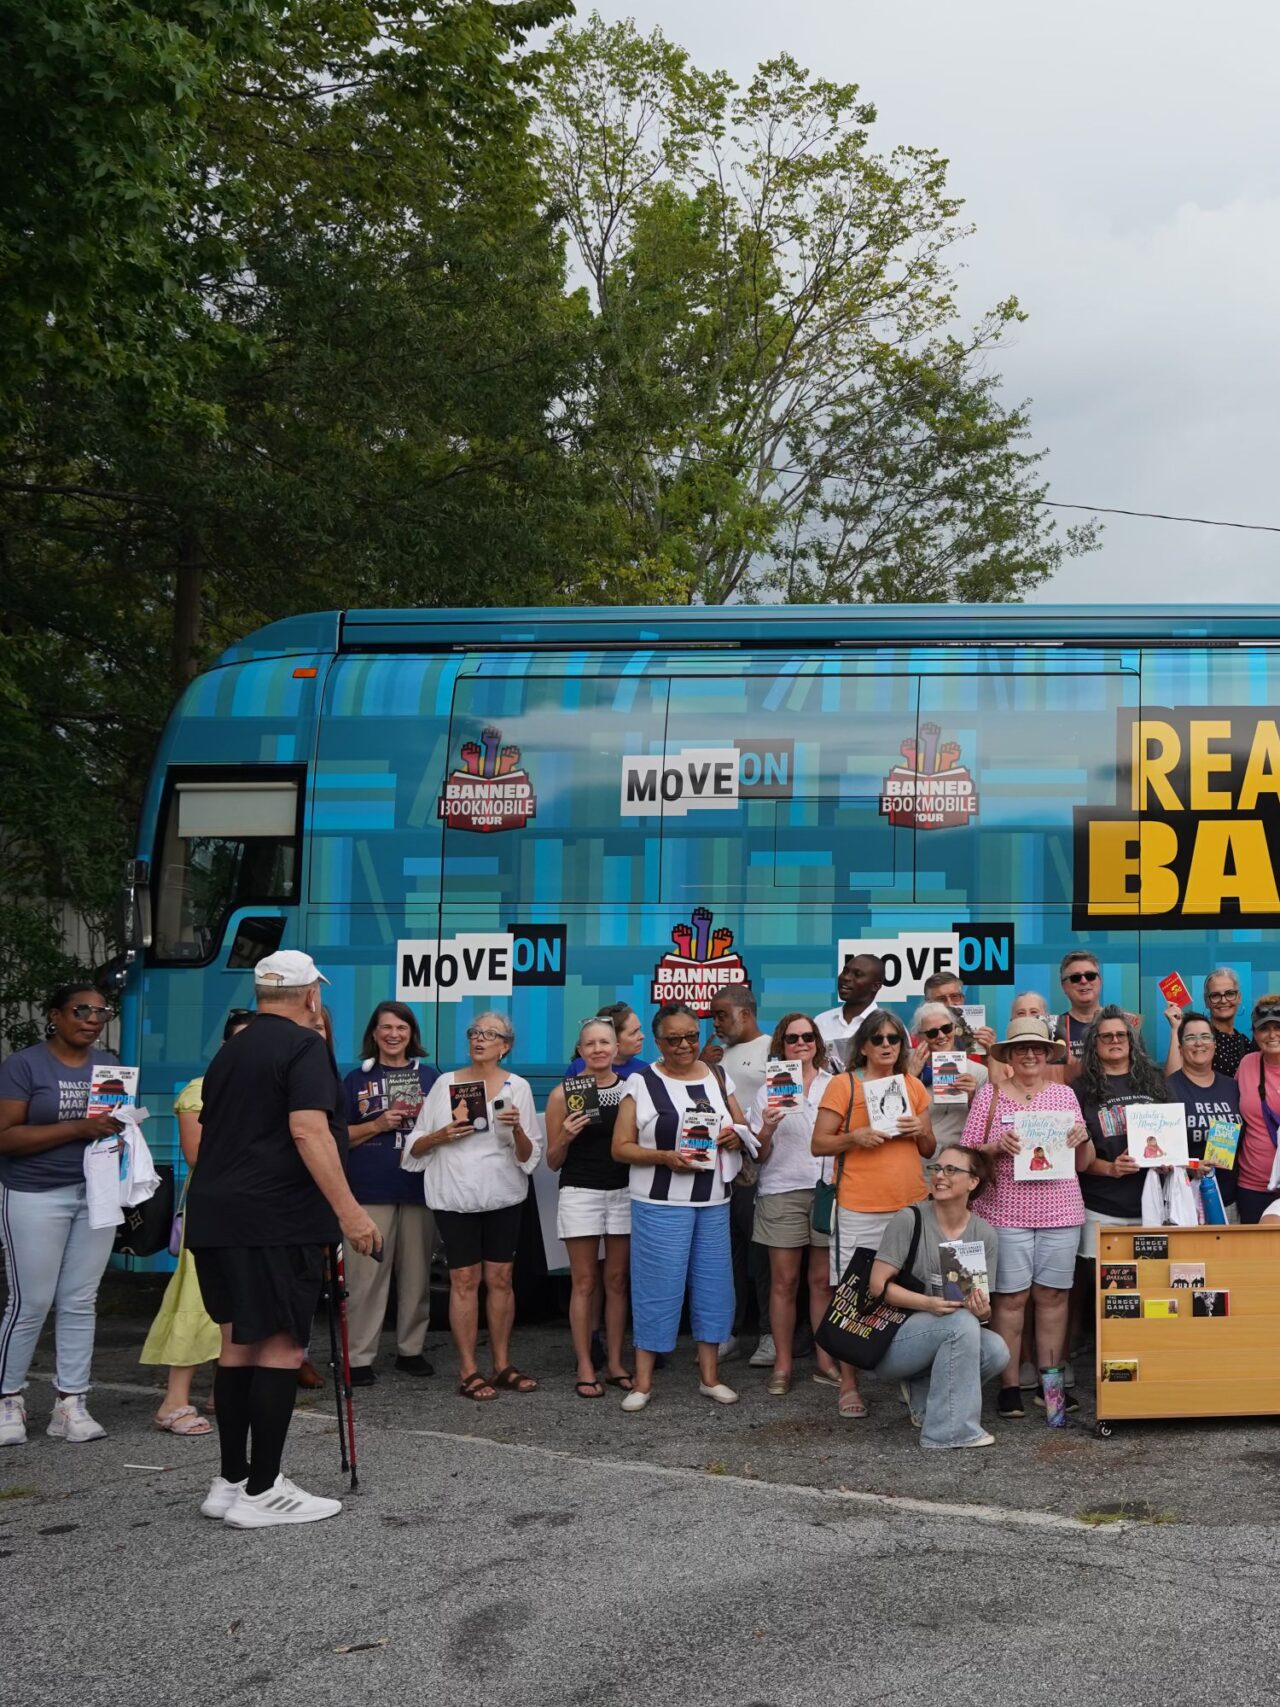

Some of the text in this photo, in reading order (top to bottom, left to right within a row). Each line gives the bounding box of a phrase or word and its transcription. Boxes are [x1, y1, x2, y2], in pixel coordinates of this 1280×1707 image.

[627, 752, 788, 802] MOVE ON
[446, 784, 530, 799] BANNED
[886, 781, 972, 795] BANNED
[441, 800, 533, 815] BOOKMOBILE
[882, 797, 976, 812] BOOKMOBILE
[471, 816, 502, 825] TOUR
[402, 938, 561, 987] MOVE ON
[844, 936, 1009, 987] OVE ON
[658, 968, 745, 983] BANNED
[654, 984, 749, 1000] BOOKMO
[684, 1001, 711, 1010] TOU
[564, 1077, 596, 1086] HUNGER
[566, 1083, 592, 1091] GAMES
[60, 1090, 90, 1099] HARR
[1195, 1102, 1231, 1113] READ
[1187, 1114, 1243, 1128] BANNED
[828, 1310, 872, 1339] IT WRONG.
